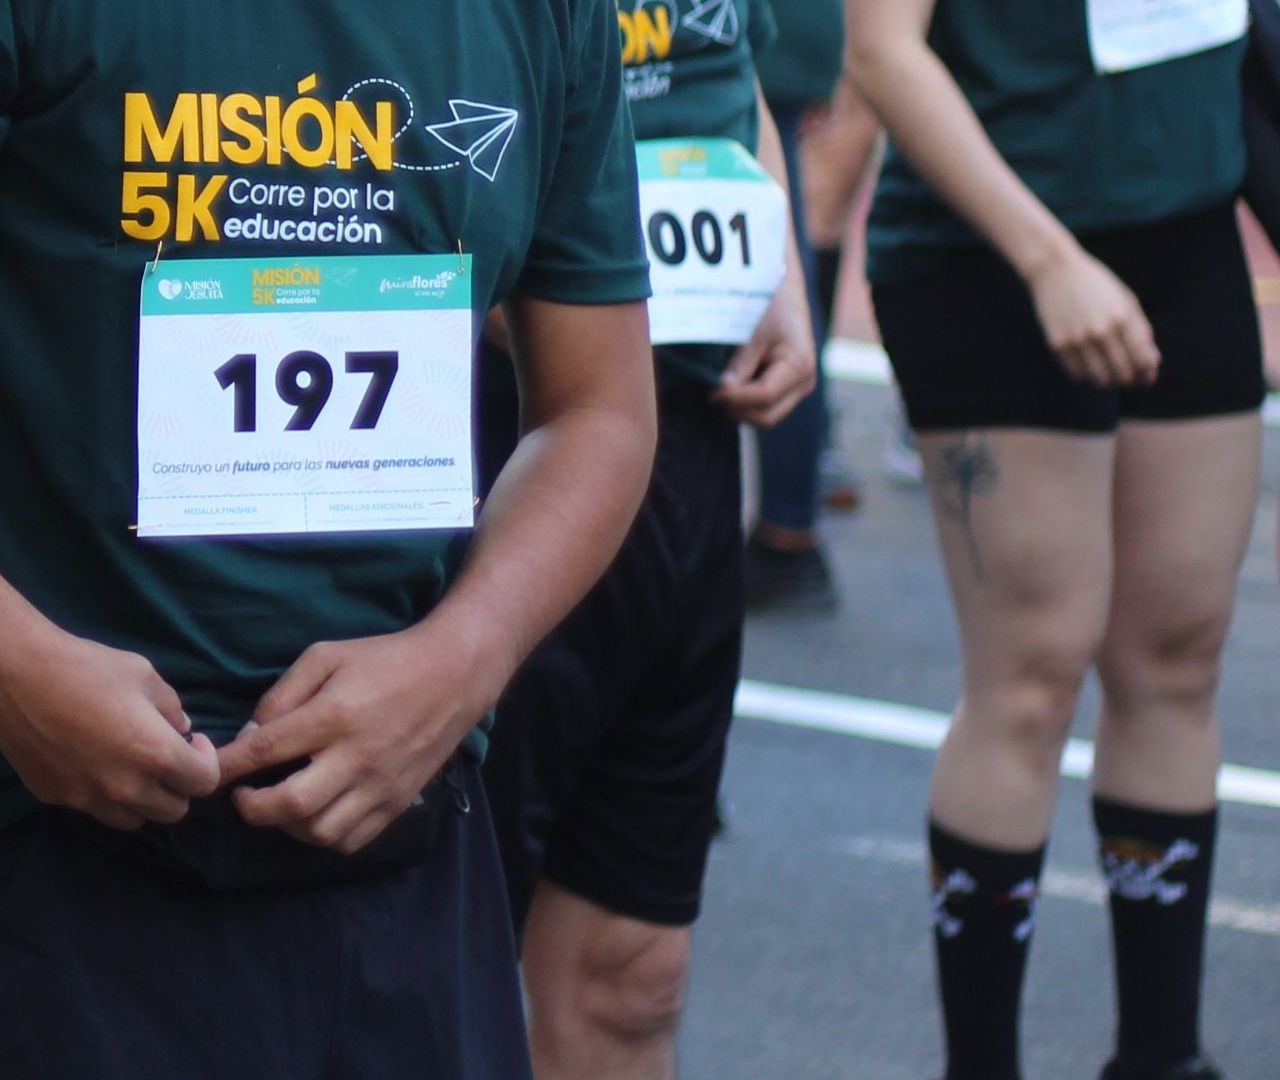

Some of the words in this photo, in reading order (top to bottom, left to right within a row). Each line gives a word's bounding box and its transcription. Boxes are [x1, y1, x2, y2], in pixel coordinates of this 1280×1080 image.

[124, 73, 392, 170] MISIÓN
[121, 172, 228, 242] 5K
[229, 178, 305, 206] Corre
[313, 186, 358, 215] por
[366, 183, 394, 211] la
[223, 212, 382, 243] educación
[648, 210, 751, 267] 001
[252, 264, 321, 286] MISIÓN
[252, 287, 276, 306] 5K
[276, 296, 317, 304] educación
[213, 349, 400, 433] 197
[152, 462, 212, 475] Construyo
[215, 463, 230, 473] un
[232, 460, 270, 474] futuro
[273, 461, 302, 473] para
[305, 459, 323, 470] las
[325, 460, 370, 470] nuevas
[372, 455, 455, 471] generaciones
